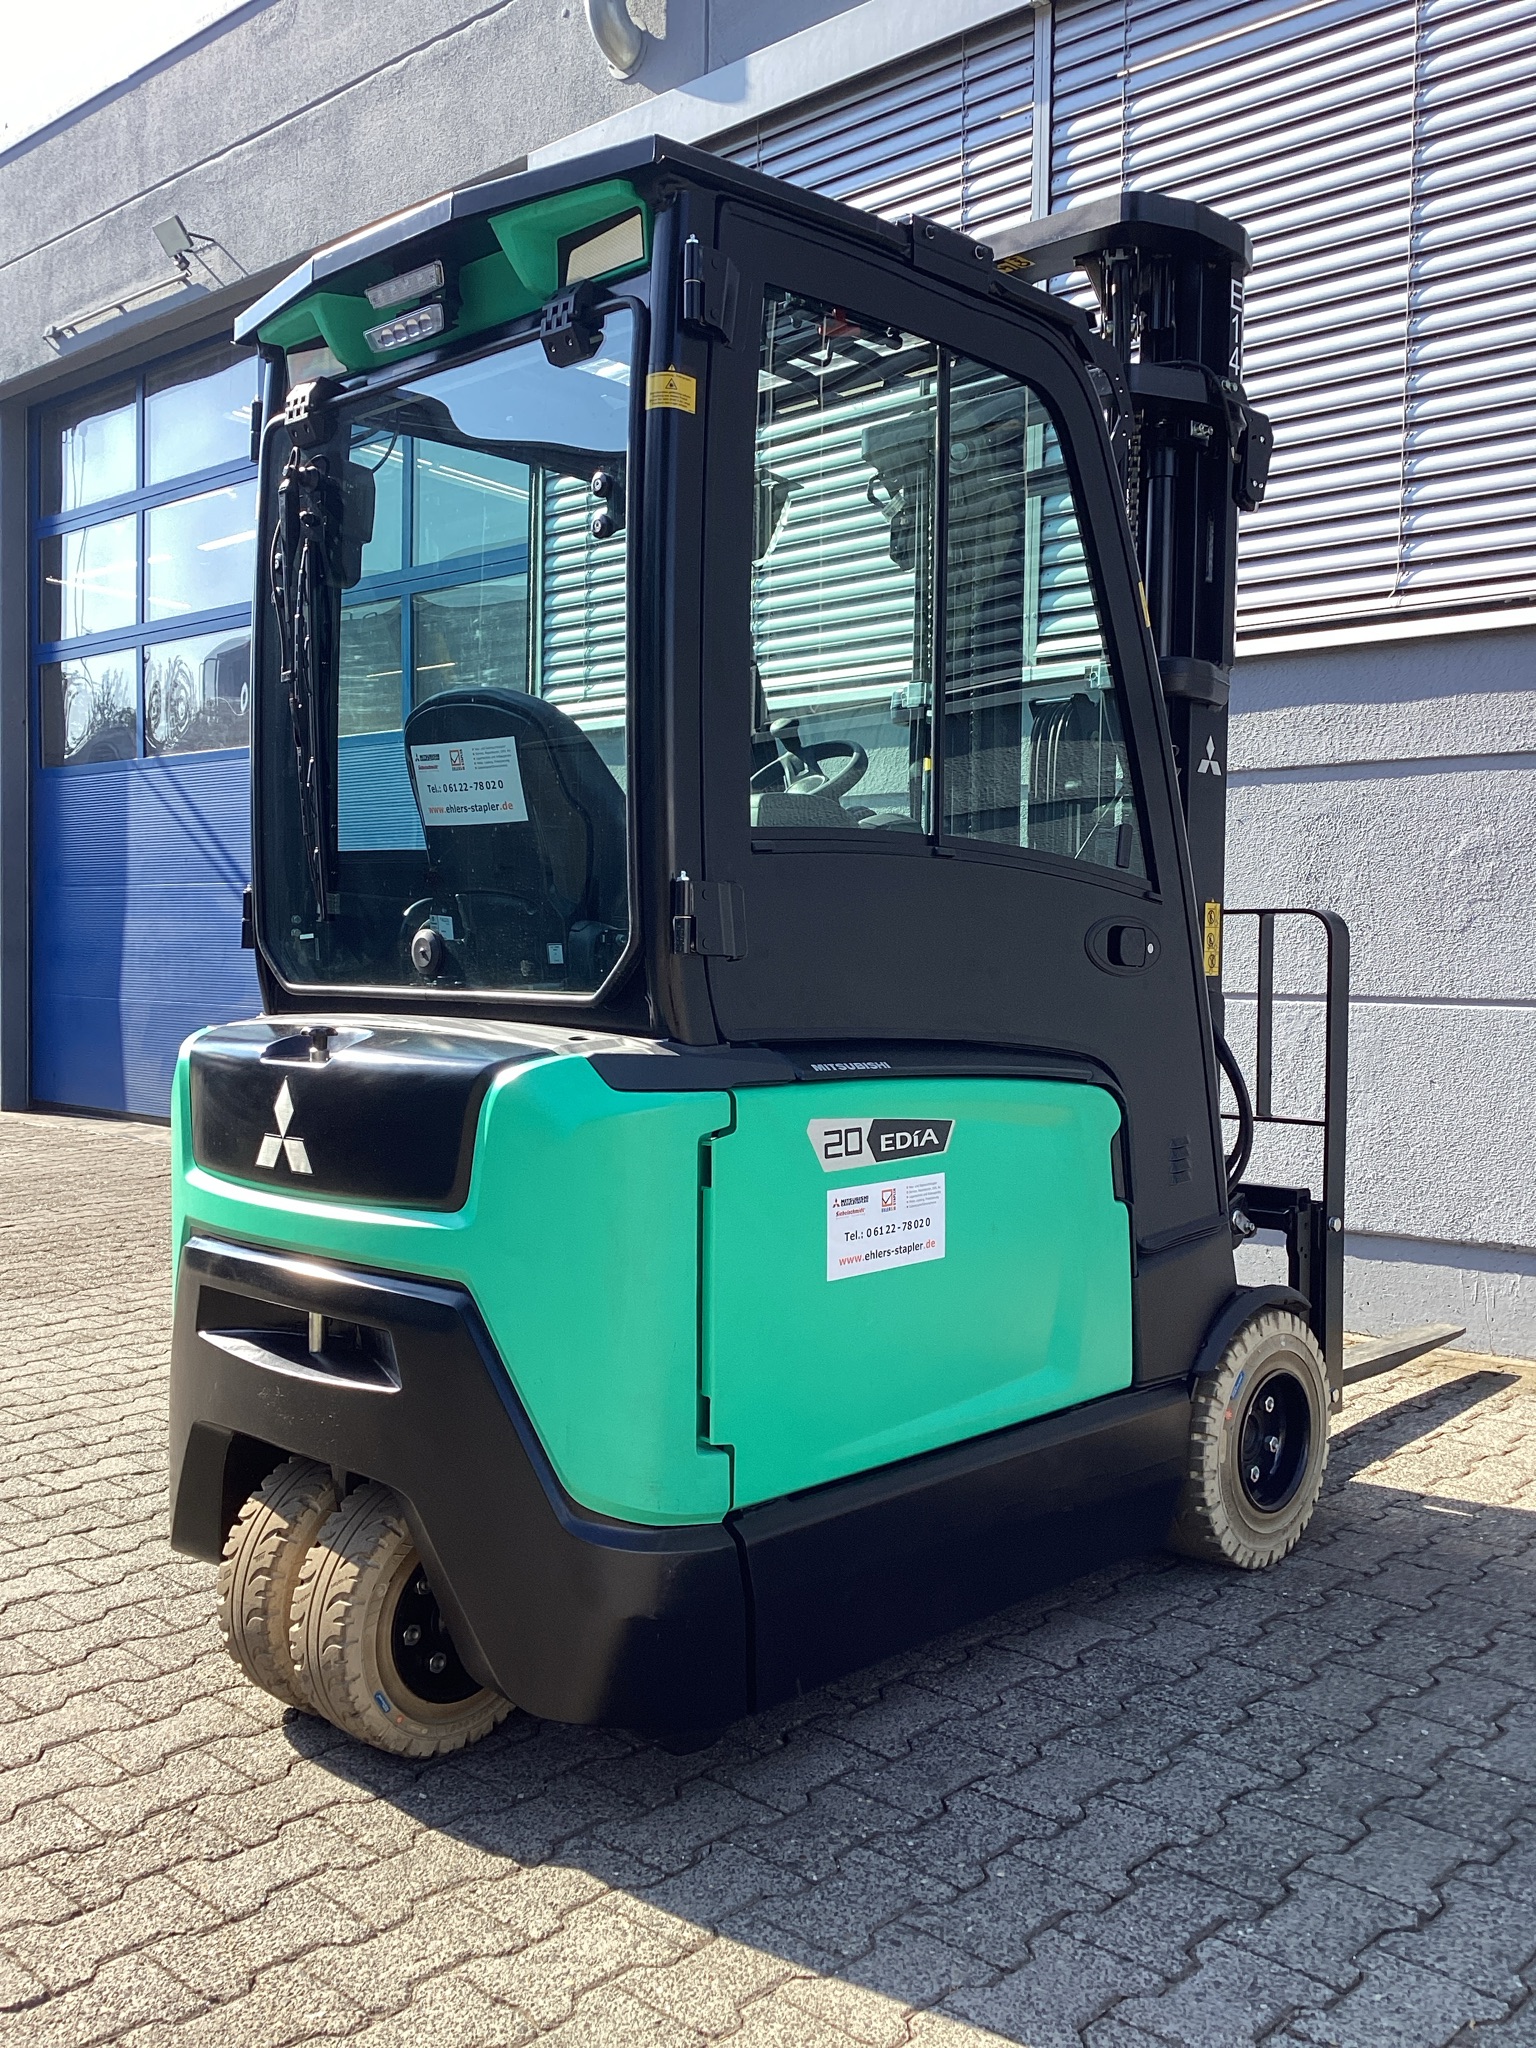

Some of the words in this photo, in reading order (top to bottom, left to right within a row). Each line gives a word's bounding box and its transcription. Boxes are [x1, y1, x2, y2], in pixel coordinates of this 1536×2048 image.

[1229, 278, 1243, 376] E14
[428, 801, 514, 814] www.ehlers-stapler.de
[810, 1061, 892, 1072] MITSUBISHI
[823, 1126, 863, 1159] 20
[844, 1230, 864, 1241] Tel.:
[838, 1239, 936, 1266] www.ehlers-stapler.de
